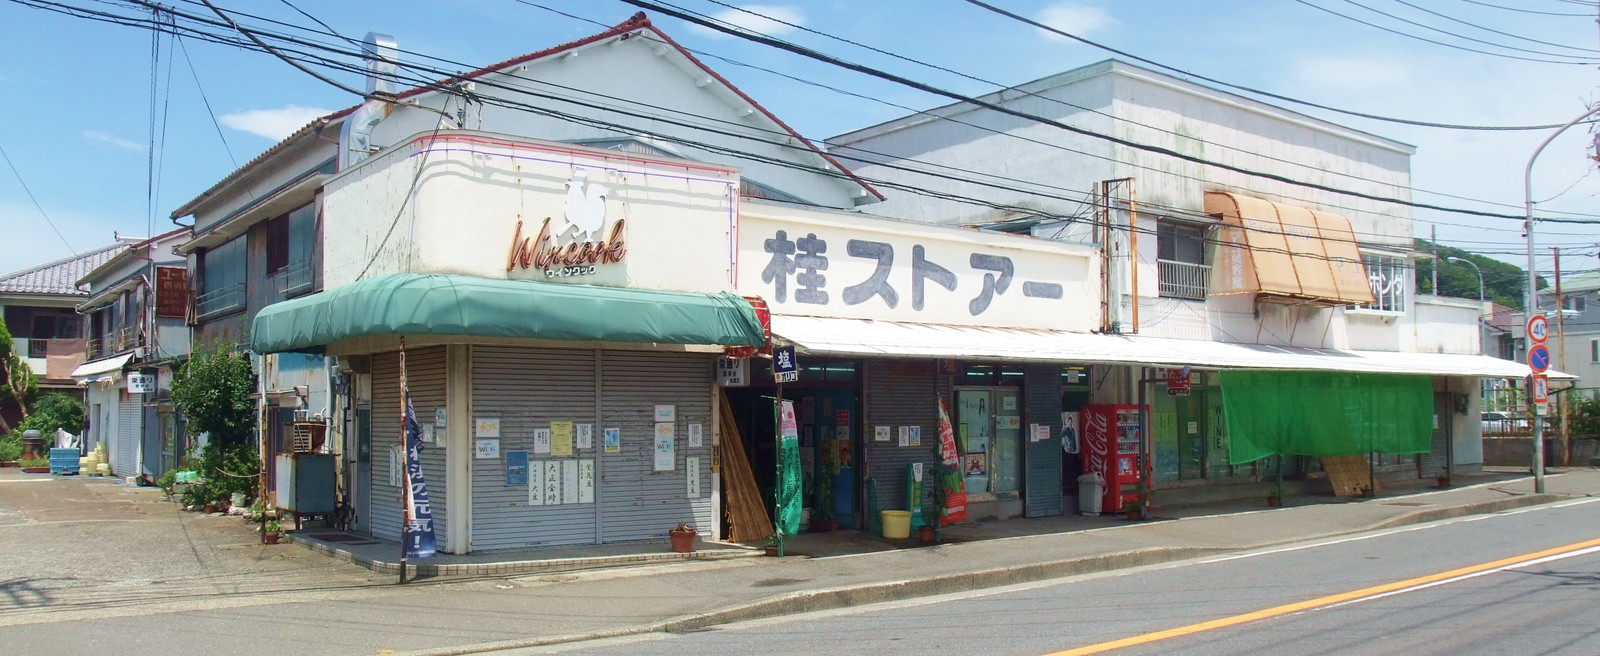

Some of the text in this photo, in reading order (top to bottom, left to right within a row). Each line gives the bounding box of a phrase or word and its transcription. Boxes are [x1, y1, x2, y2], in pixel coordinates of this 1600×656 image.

[507, 217, 626, 272] Wincook
[546, 265, 597, 279] ウインクック
[761, 230, 1064, 316] 桂ストアー
[1369, 270, 1404, 296] ホンダ
[1533, 323, 1545, 336] 40
[777, 349, 793, 369] 塩
[781, 371, 797, 382] オリコ
[1214, 404, 1223, 449] WINE
[547, 464, 557, 502] 大正金時
